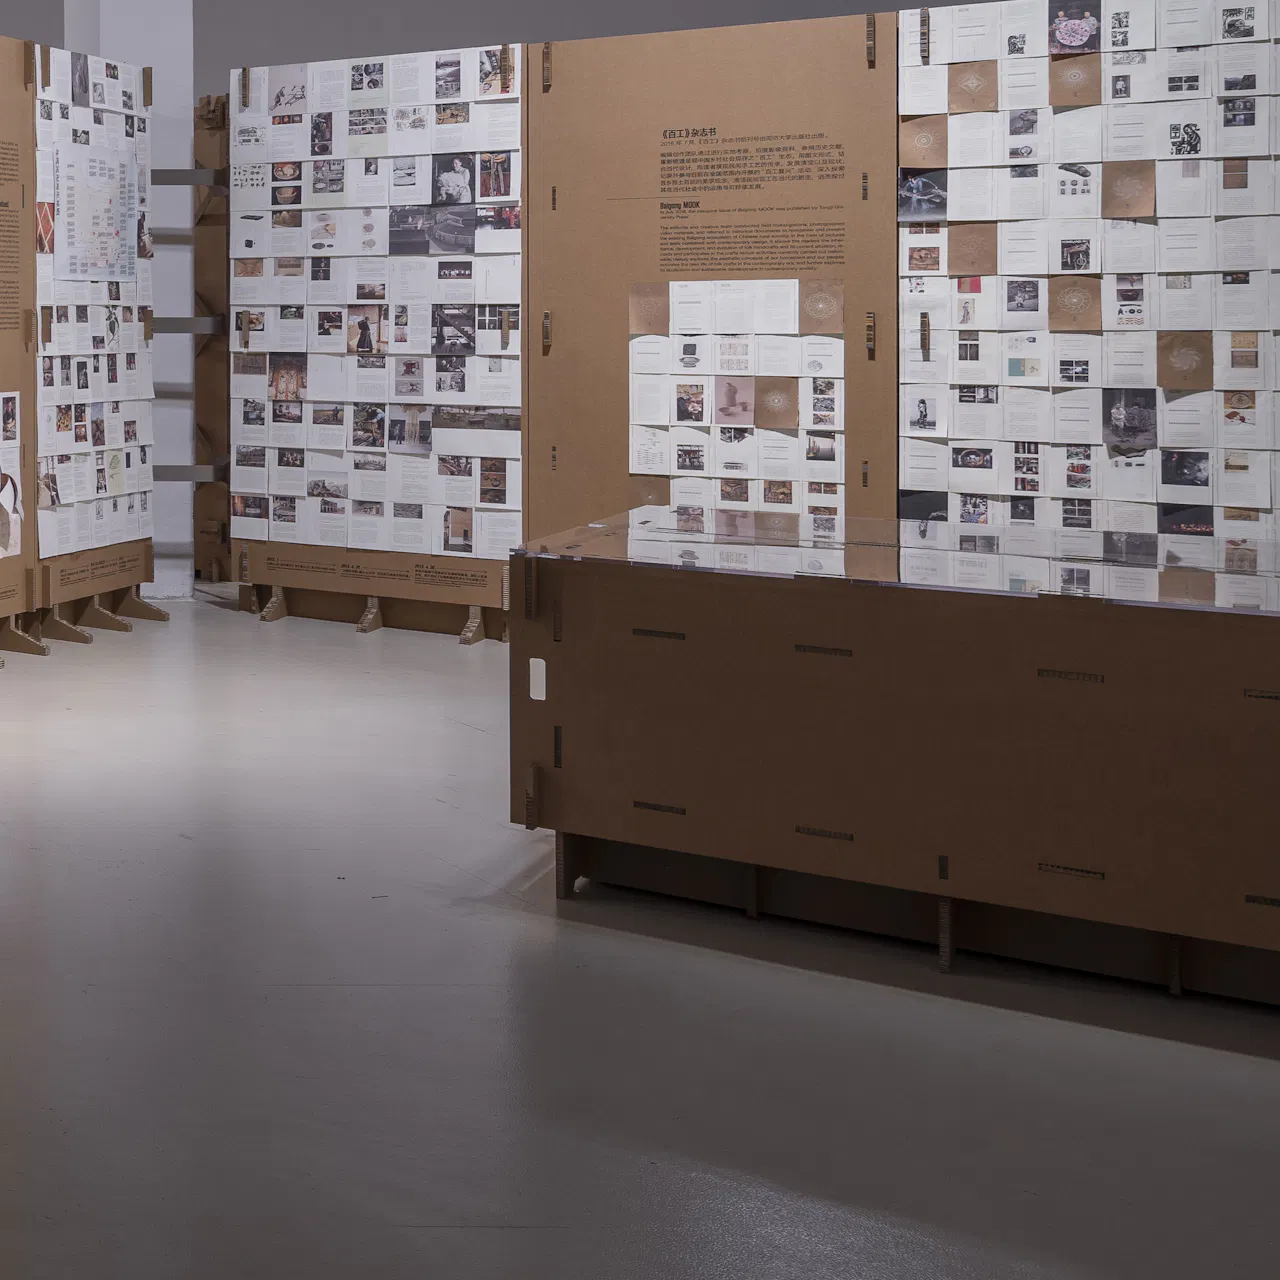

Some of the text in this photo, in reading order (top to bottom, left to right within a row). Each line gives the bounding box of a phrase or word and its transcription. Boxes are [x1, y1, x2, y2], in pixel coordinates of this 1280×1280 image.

[662, 127, 717, 140] 《百工》杂志书
[660, 201, 700, 210] Baigong MOOK
